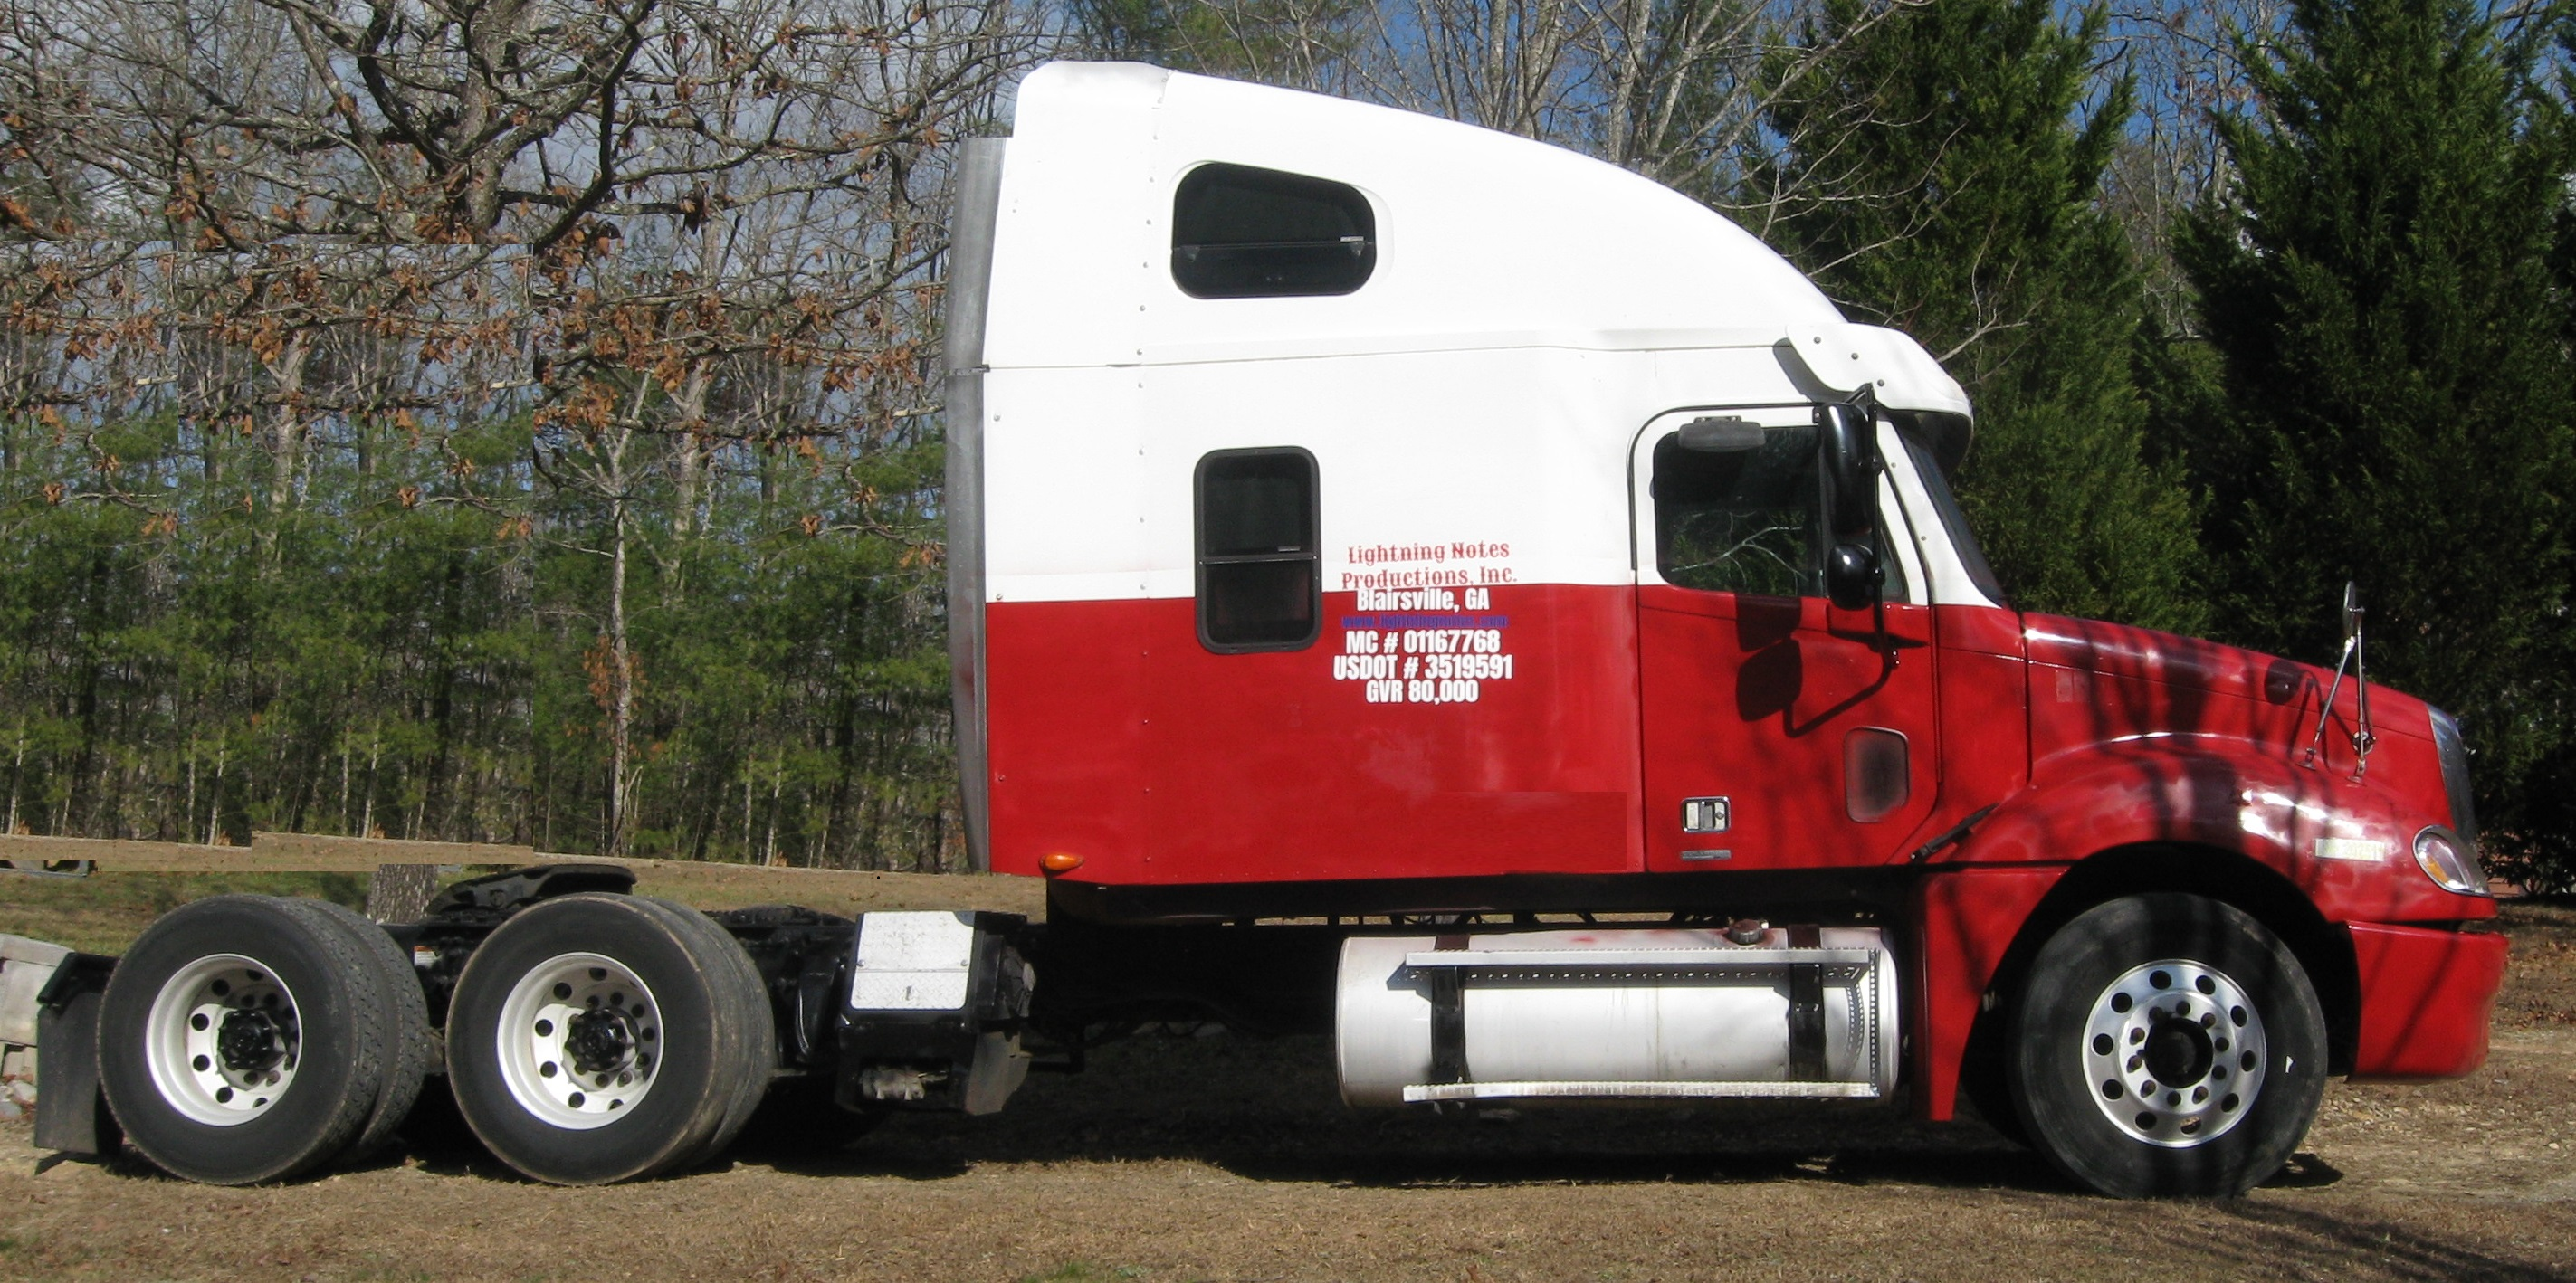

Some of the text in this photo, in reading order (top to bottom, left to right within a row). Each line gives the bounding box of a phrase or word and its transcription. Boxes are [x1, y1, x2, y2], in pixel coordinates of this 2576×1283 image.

[1349, 541, 1510, 565] Lightning Notes
[1341, 566, 1518, 590] Productions, Inc.
[1357, 588, 1490, 613] Blairsville, GA
[1346, 630, 1501, 654] MC # 01167768
[1333, 654, 1513, 680] USDOT # 3519591
[1366, 680, 1479, 705] GVR 80,000
